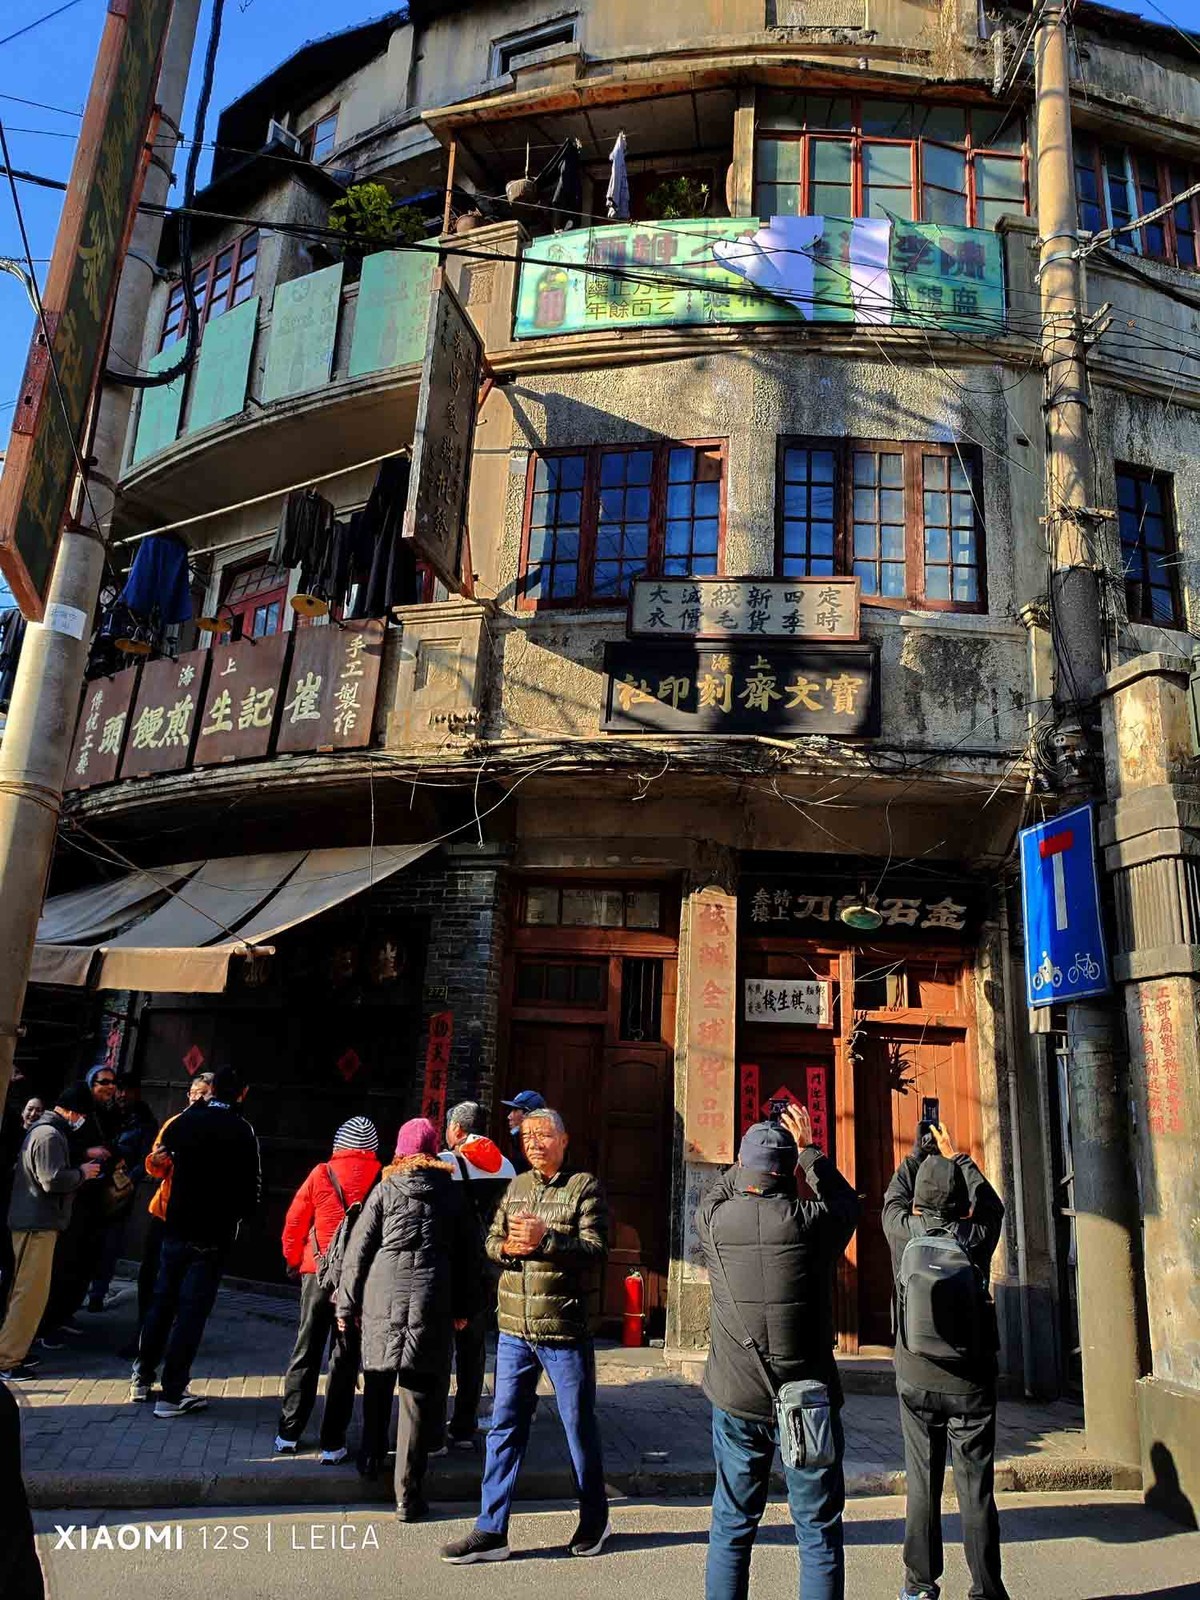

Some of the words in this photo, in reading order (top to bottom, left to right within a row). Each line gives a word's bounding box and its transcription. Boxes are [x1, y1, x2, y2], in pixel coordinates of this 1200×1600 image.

[711, 654, 772, 673] 上海
[333, 634, 368, 737] 手工製作
[793, 894, 968, 931] 金石刀
